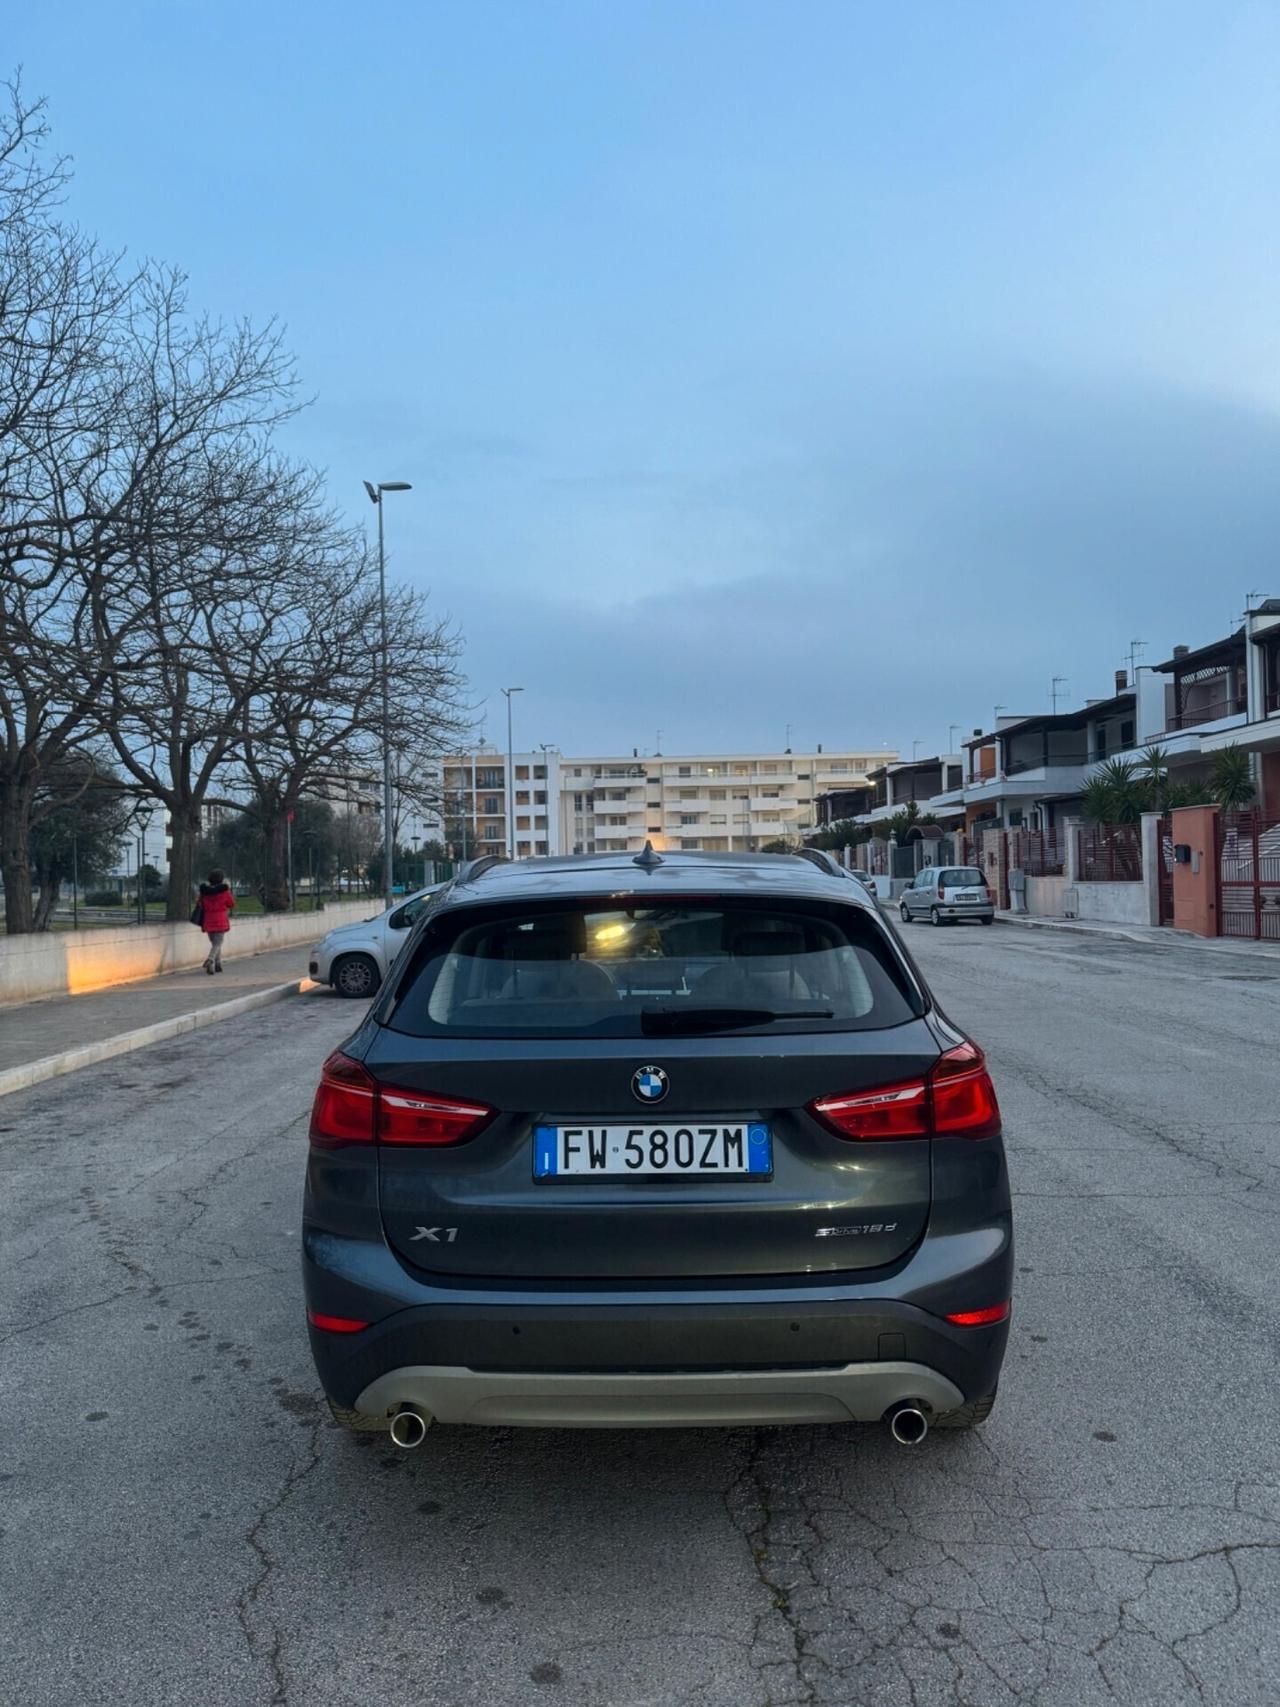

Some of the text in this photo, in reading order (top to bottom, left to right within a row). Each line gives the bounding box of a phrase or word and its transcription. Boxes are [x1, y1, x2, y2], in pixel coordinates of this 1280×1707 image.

[563, 1128, 744, 1170] FW 580ZM
[408, 1226, 459, 1243] X1
